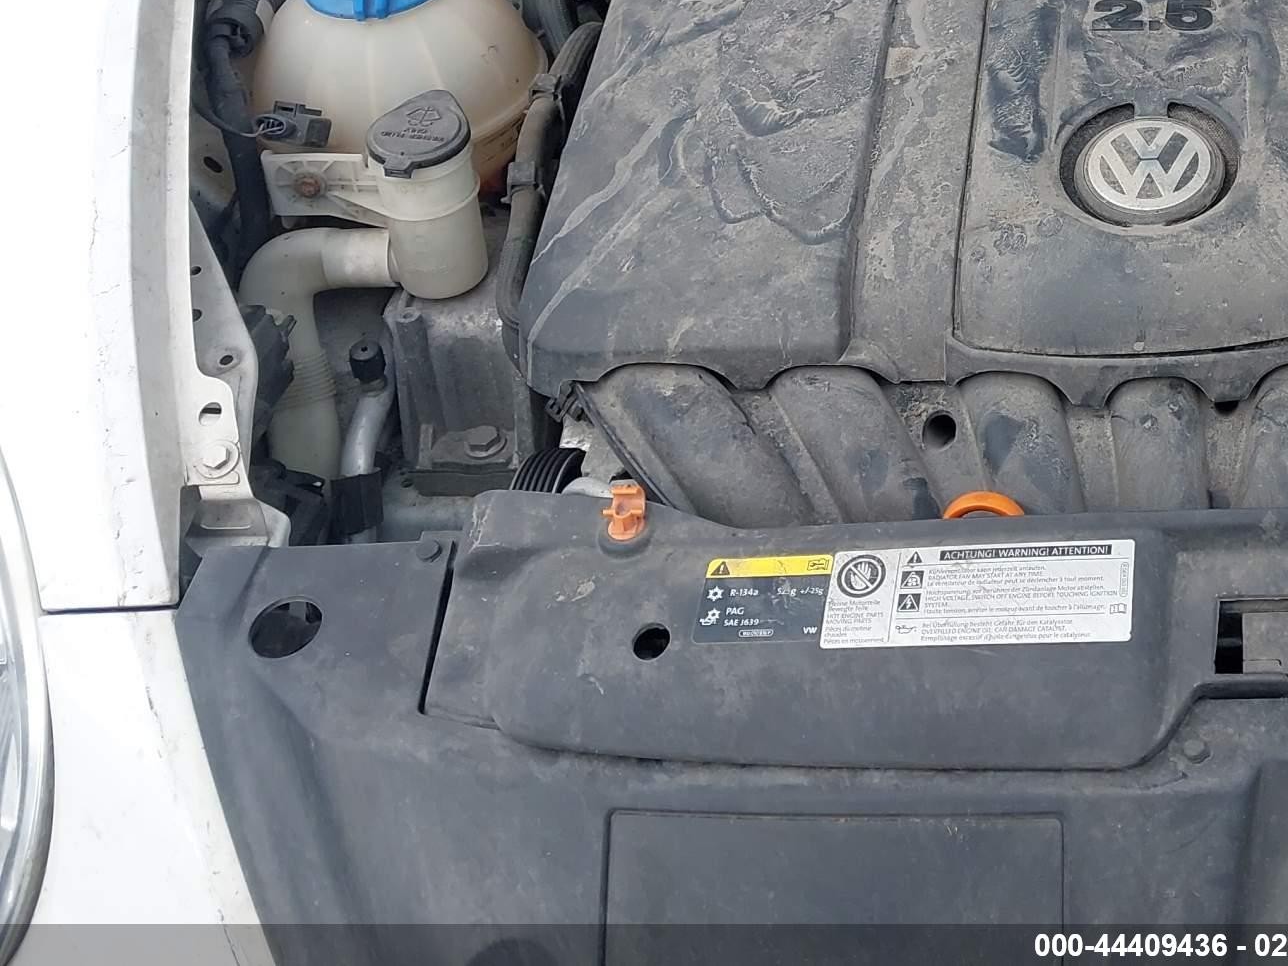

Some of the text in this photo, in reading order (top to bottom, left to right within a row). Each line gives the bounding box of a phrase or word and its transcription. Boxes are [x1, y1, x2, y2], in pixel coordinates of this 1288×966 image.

[944, 545, 1109, 560] ACHTUNG! WARNING! ATTENTION!
[730, 588, 759, 597] R-134a
[725, 606, 745, 615] PAG
[723, 618, 760, 627] SAE J639
[803, 626, 818, 635] VW
